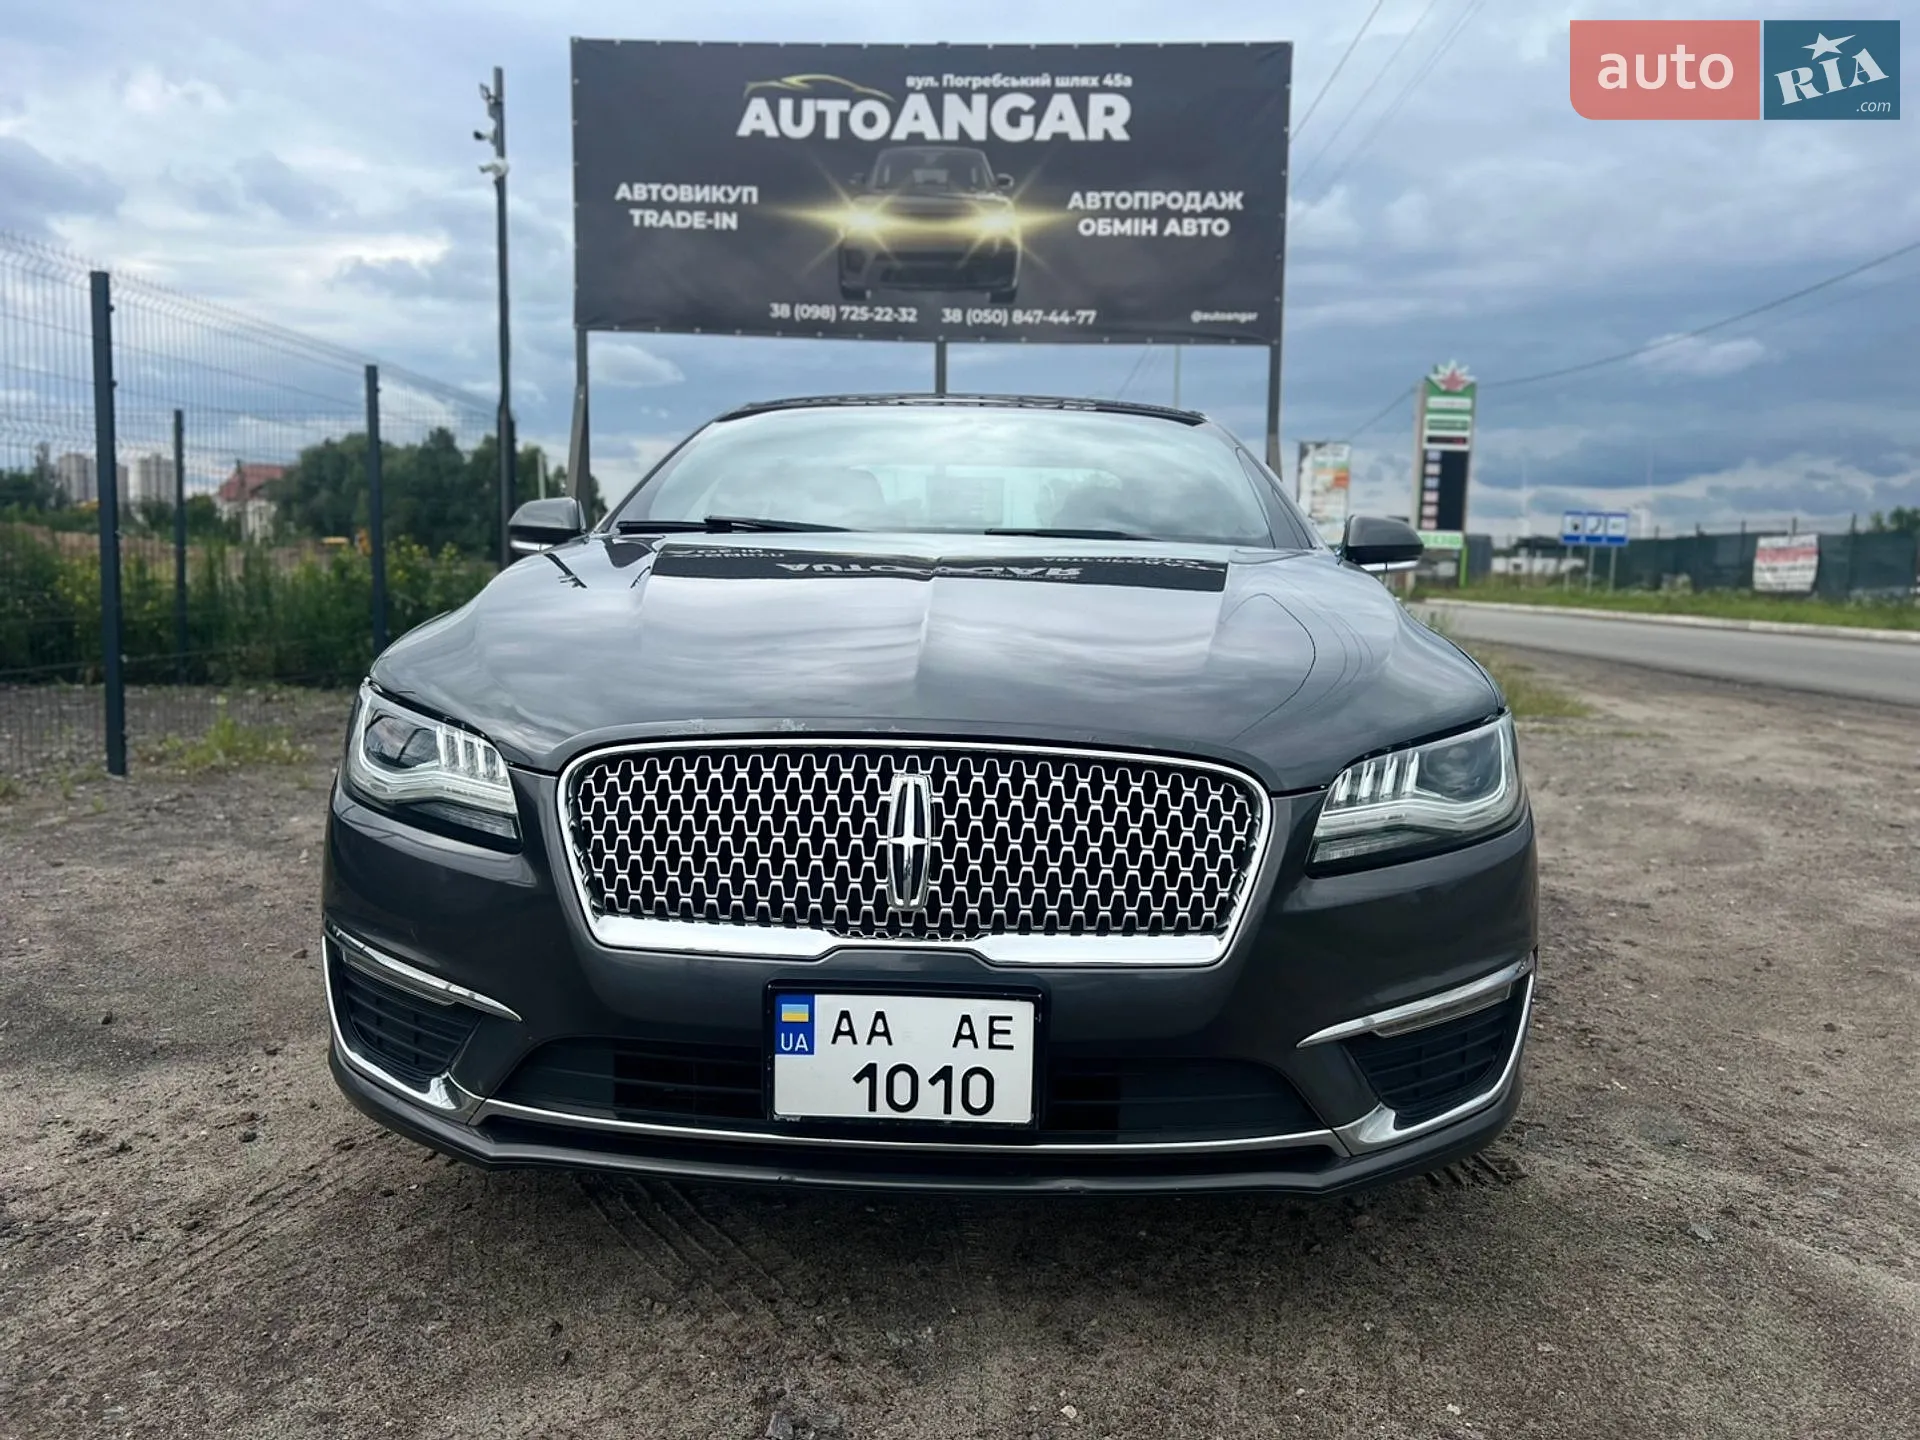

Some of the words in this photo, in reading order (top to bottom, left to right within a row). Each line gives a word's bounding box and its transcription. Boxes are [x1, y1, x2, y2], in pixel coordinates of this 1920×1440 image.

[906, 75, 939, 90] вул.
[943, 73, 1051, 90] Погребський
[1056, 75, 1099, 88] шлях
[736, 92, 1131, 142] AUTOANGAR
[615, 182, 759, 204] АВТОВИКУП
[1067, 190, 1244, 213] АВТОПРОДАЖ
[629, 208, 738, 230] TRADE-IN
[1078, 217, 1158, 237] ОБМІН
[1163, 217, 1230, 237] АВТО
[769, 303, 790, 318] 38
[794, 304, 836, 322] (098)
[840, 305, 917, 322] 725-22-32
[941, 308, 962, 323] 38
[966, 308, 1007, 326] (050)
[1012, 309, 1096, 324] 847-44-77
[831, 1010, 893, 1046] AA
[952, 1014, 1014, 1050] AE
[780, 1033, 809, 1052] UA
[853, 1062, 995, 1116] 1010
